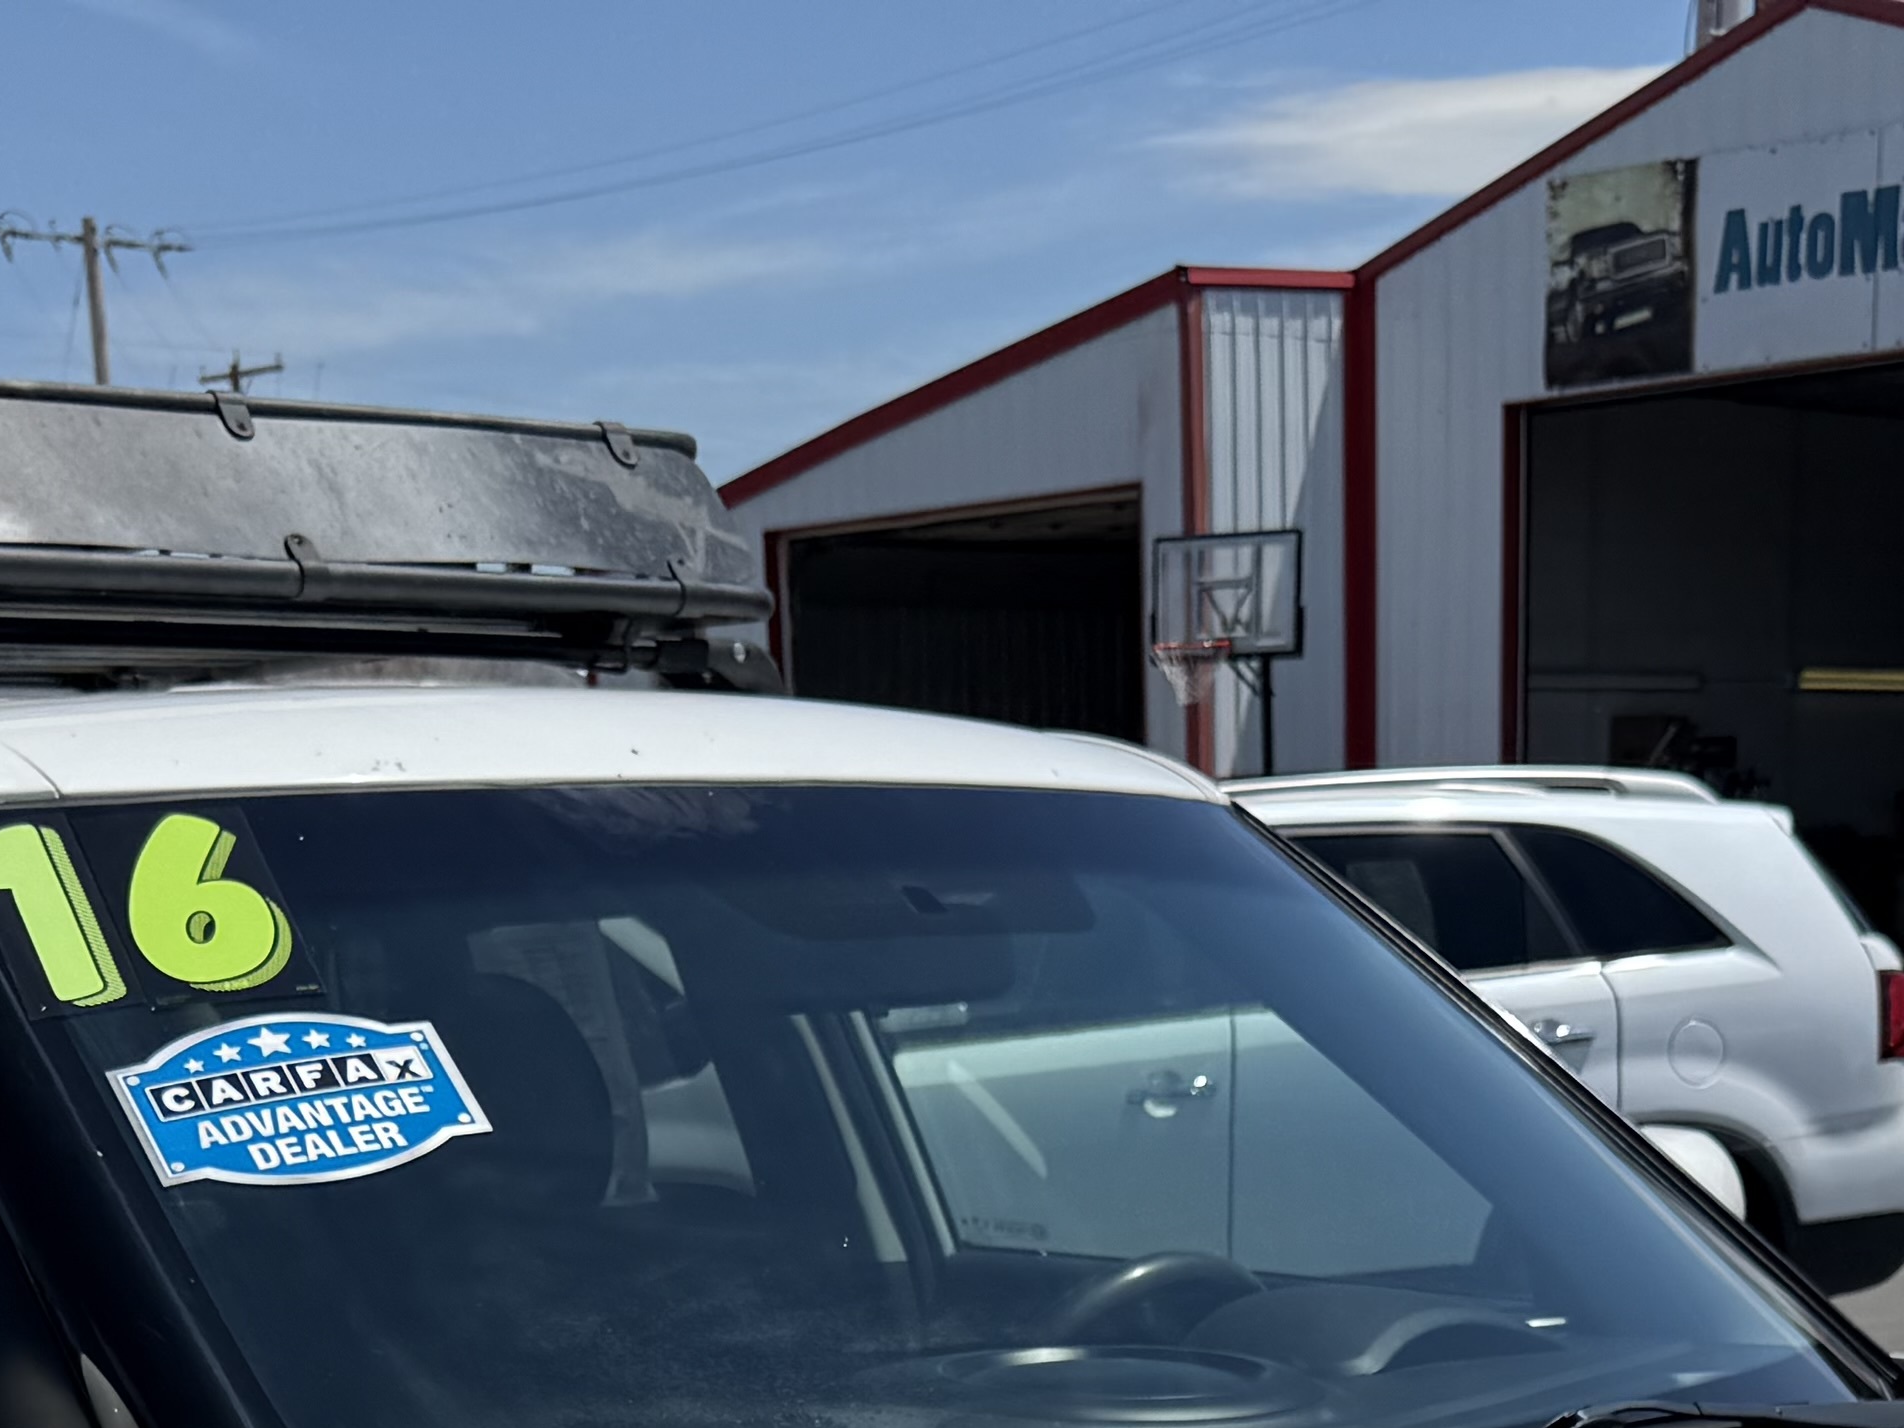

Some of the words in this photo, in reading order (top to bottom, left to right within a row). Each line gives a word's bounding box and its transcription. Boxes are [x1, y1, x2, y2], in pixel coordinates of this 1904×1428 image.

[157, 1057, 420, 1115] CARFAX
[198, 1086, 430, 1148] ADVANTAGE
[249, 1123, 408, 1171] DEALER
